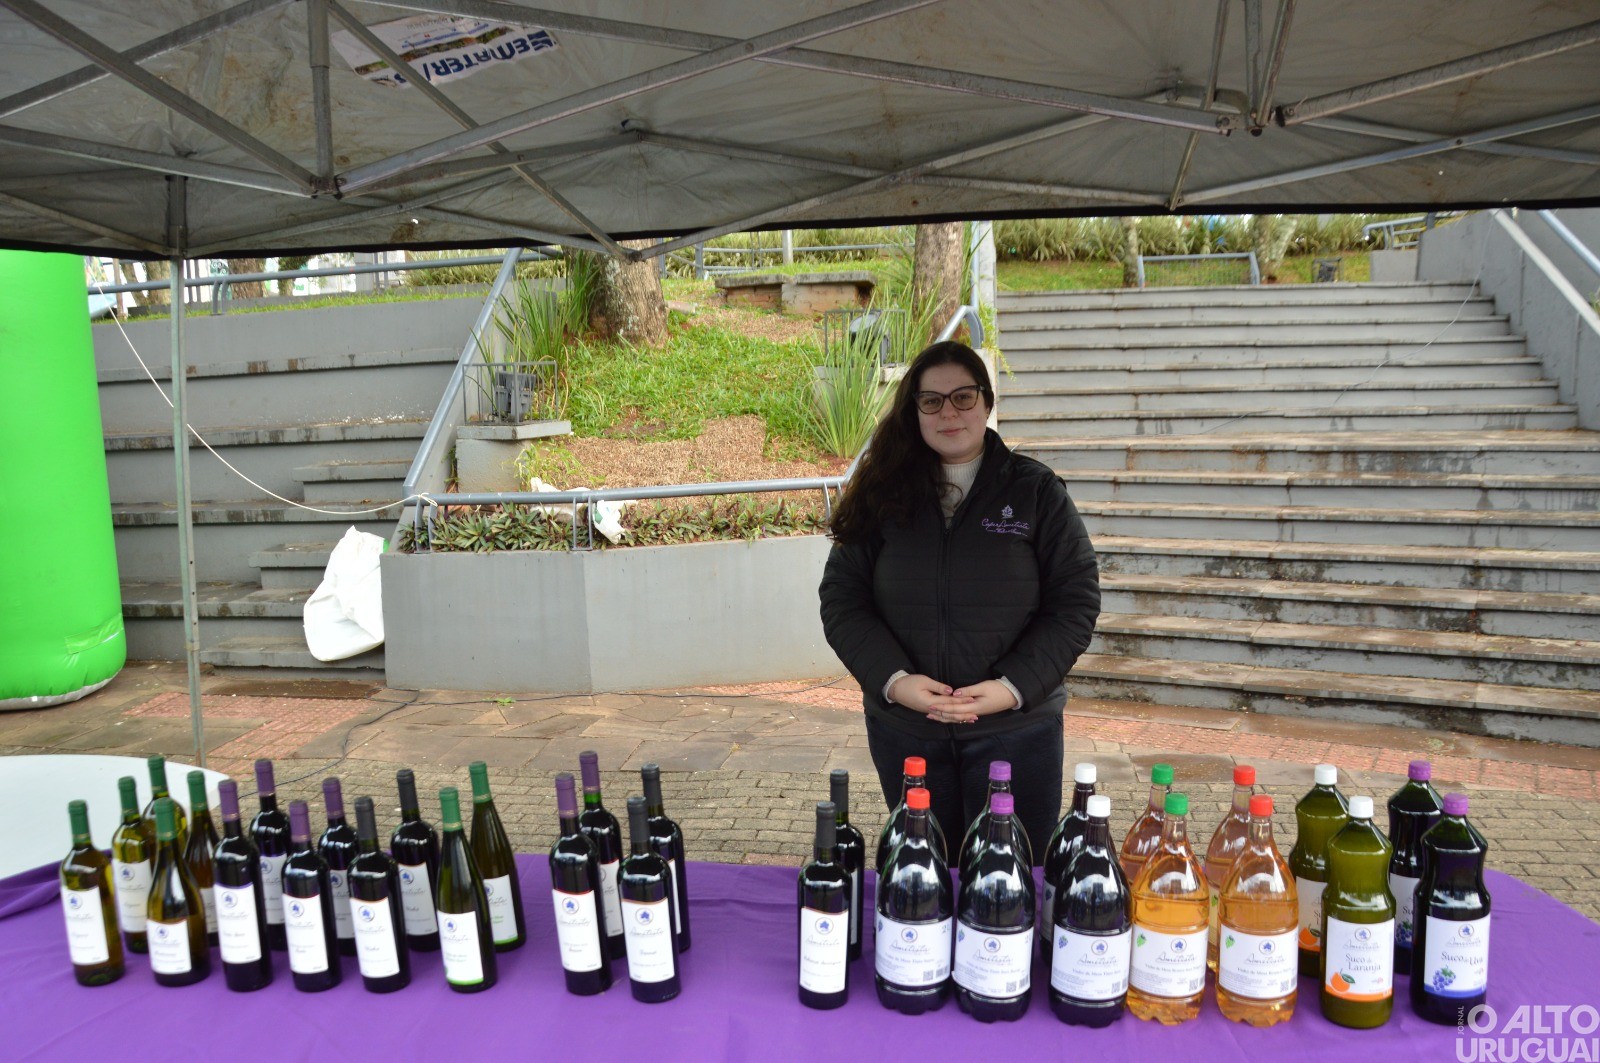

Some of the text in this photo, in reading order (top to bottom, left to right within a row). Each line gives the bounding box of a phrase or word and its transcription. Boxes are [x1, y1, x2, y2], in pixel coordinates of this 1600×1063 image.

[1345, 953, 1366, 963] Suco
[1441, 951, 1463, 963] Suco
[1348, 962, 1382, 974] Laranja
